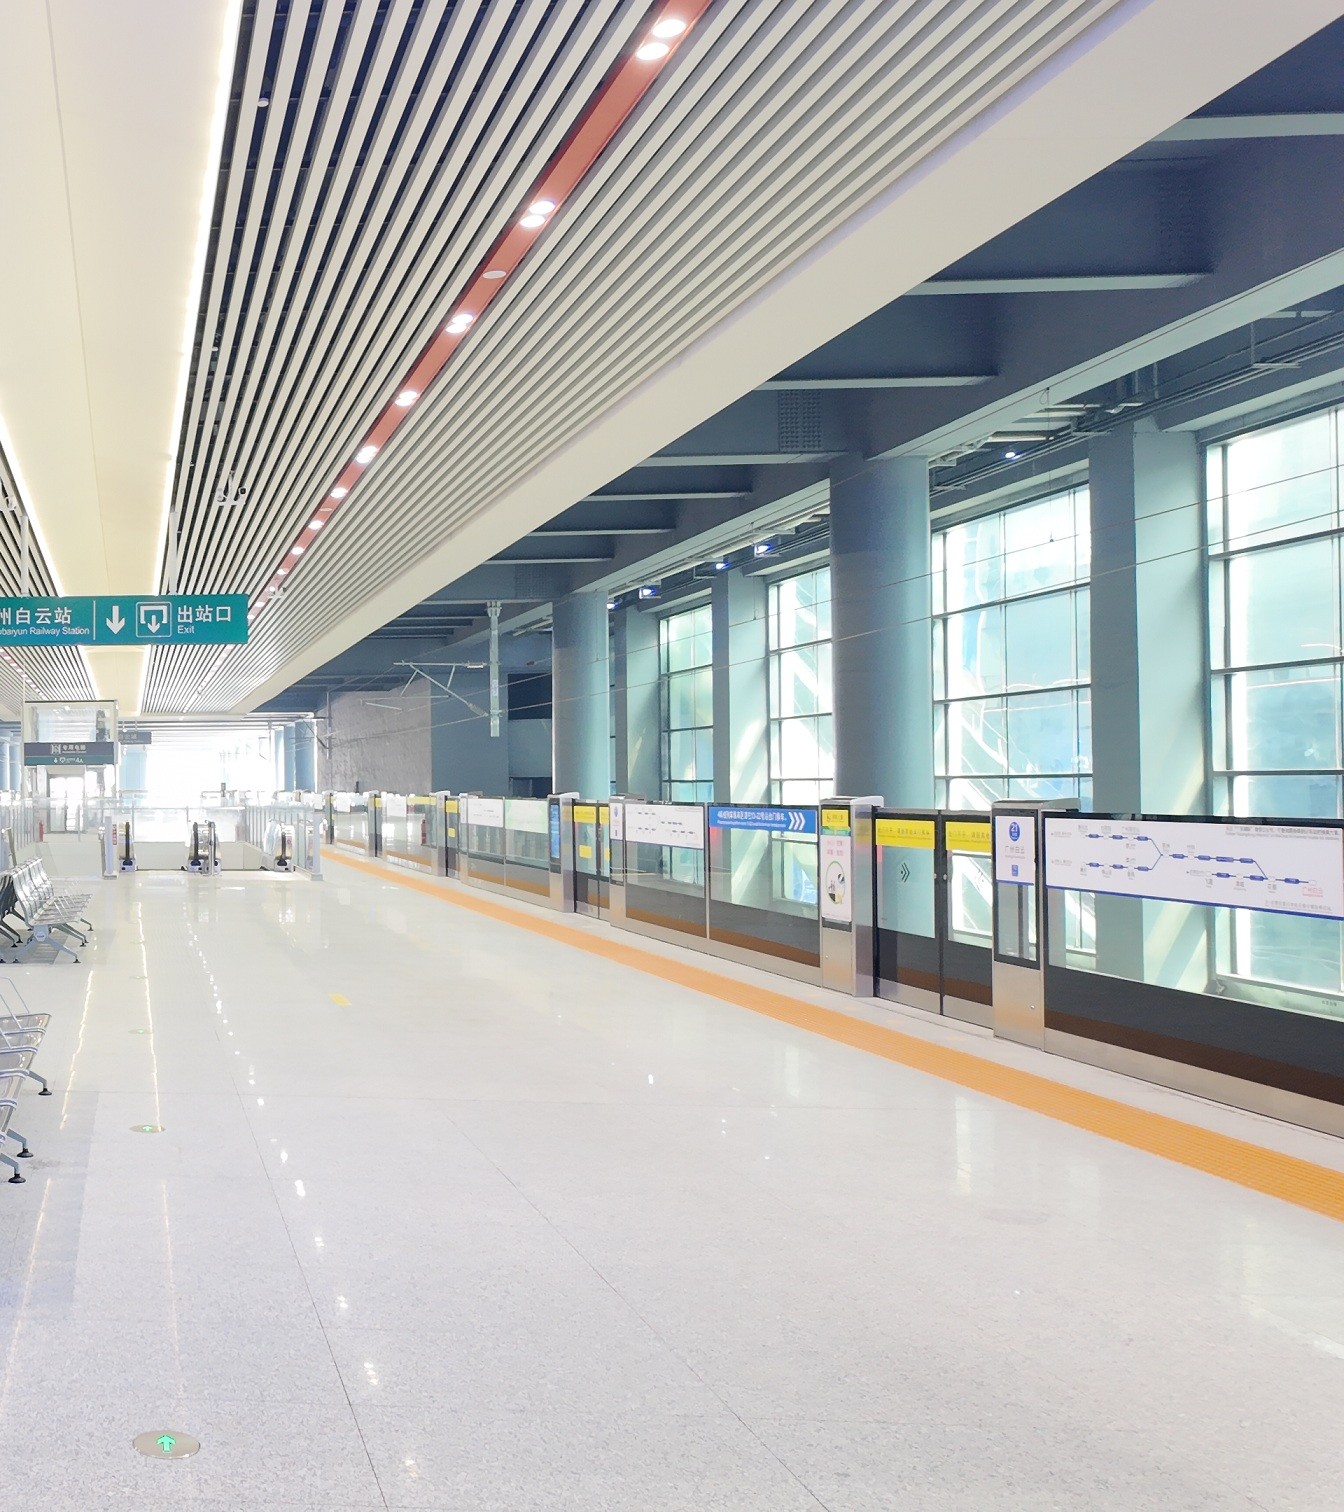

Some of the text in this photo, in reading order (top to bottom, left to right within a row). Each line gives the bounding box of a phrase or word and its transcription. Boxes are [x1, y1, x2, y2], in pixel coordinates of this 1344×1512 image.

[176, 605, 232, 623] 出站口
[29, 627, 61, 637] Railway
[62, 626, 90, 636] Station
[177, 625, 195, 634] Exit
[1010, 823, 1019, 832] 21
